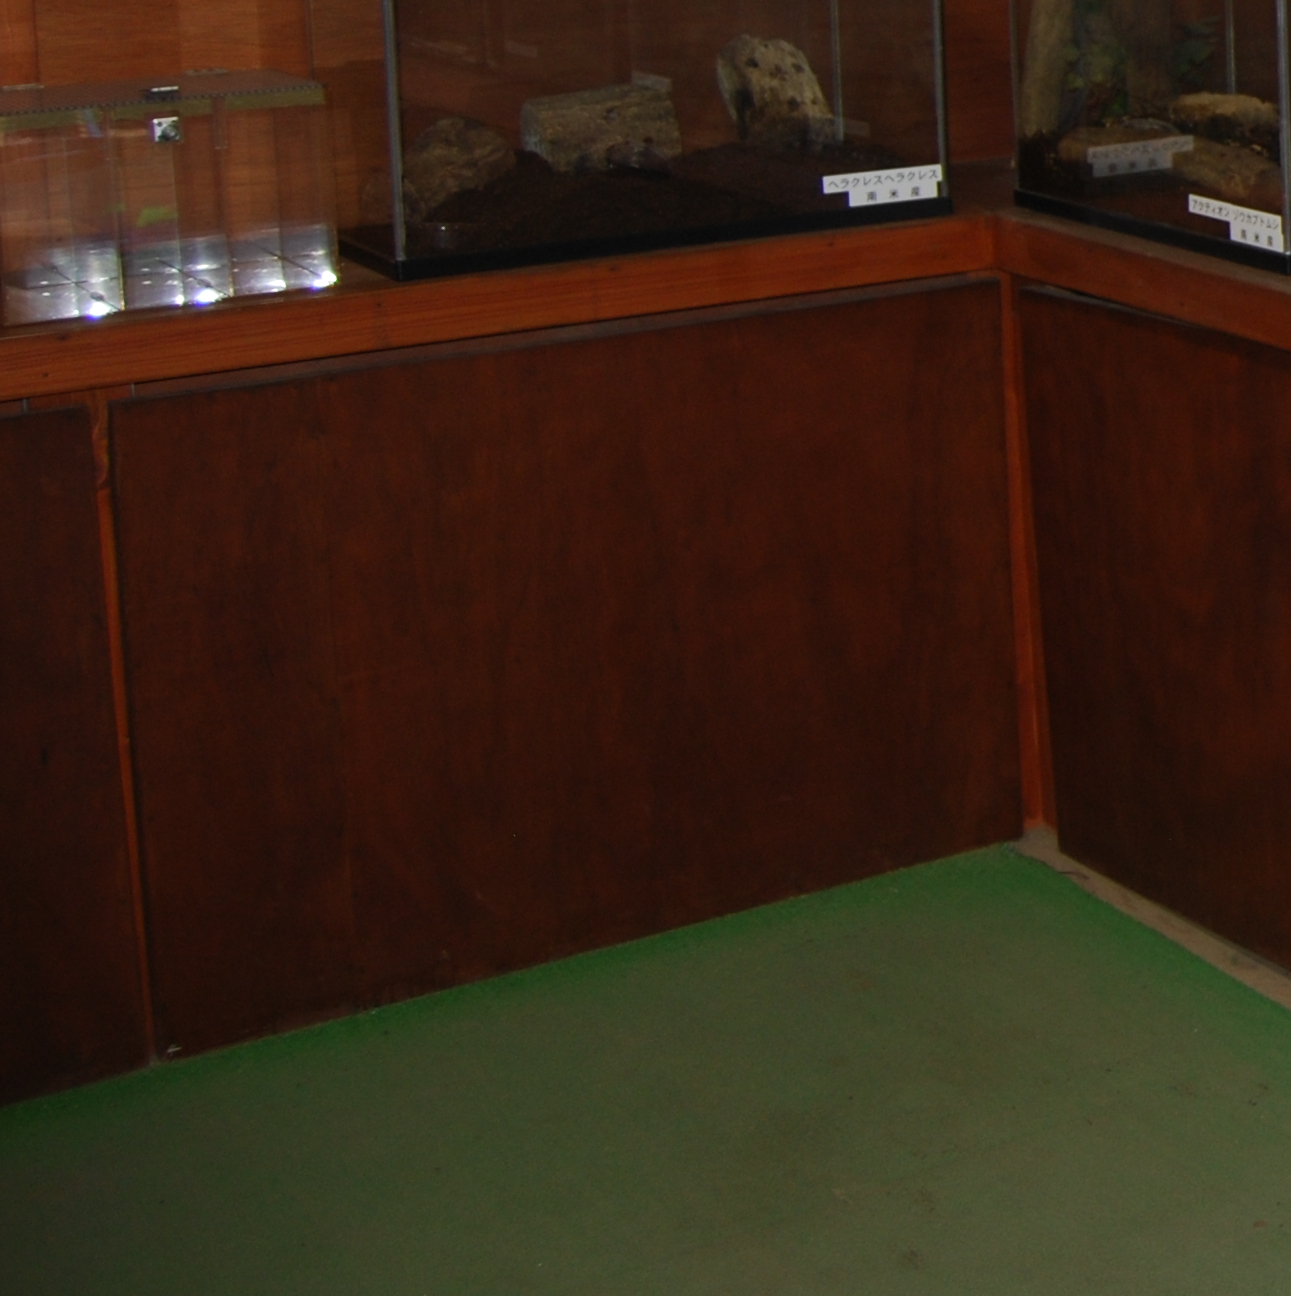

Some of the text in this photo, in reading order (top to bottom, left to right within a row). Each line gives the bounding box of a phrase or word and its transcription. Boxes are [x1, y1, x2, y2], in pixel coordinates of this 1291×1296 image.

[828, 169, 938, 189] ヘラクレスヘラクレス
[866, 186, 921, 202] 南米産
[1192, 199, 1279, 231] アクティオン ゾウカブトムシ
